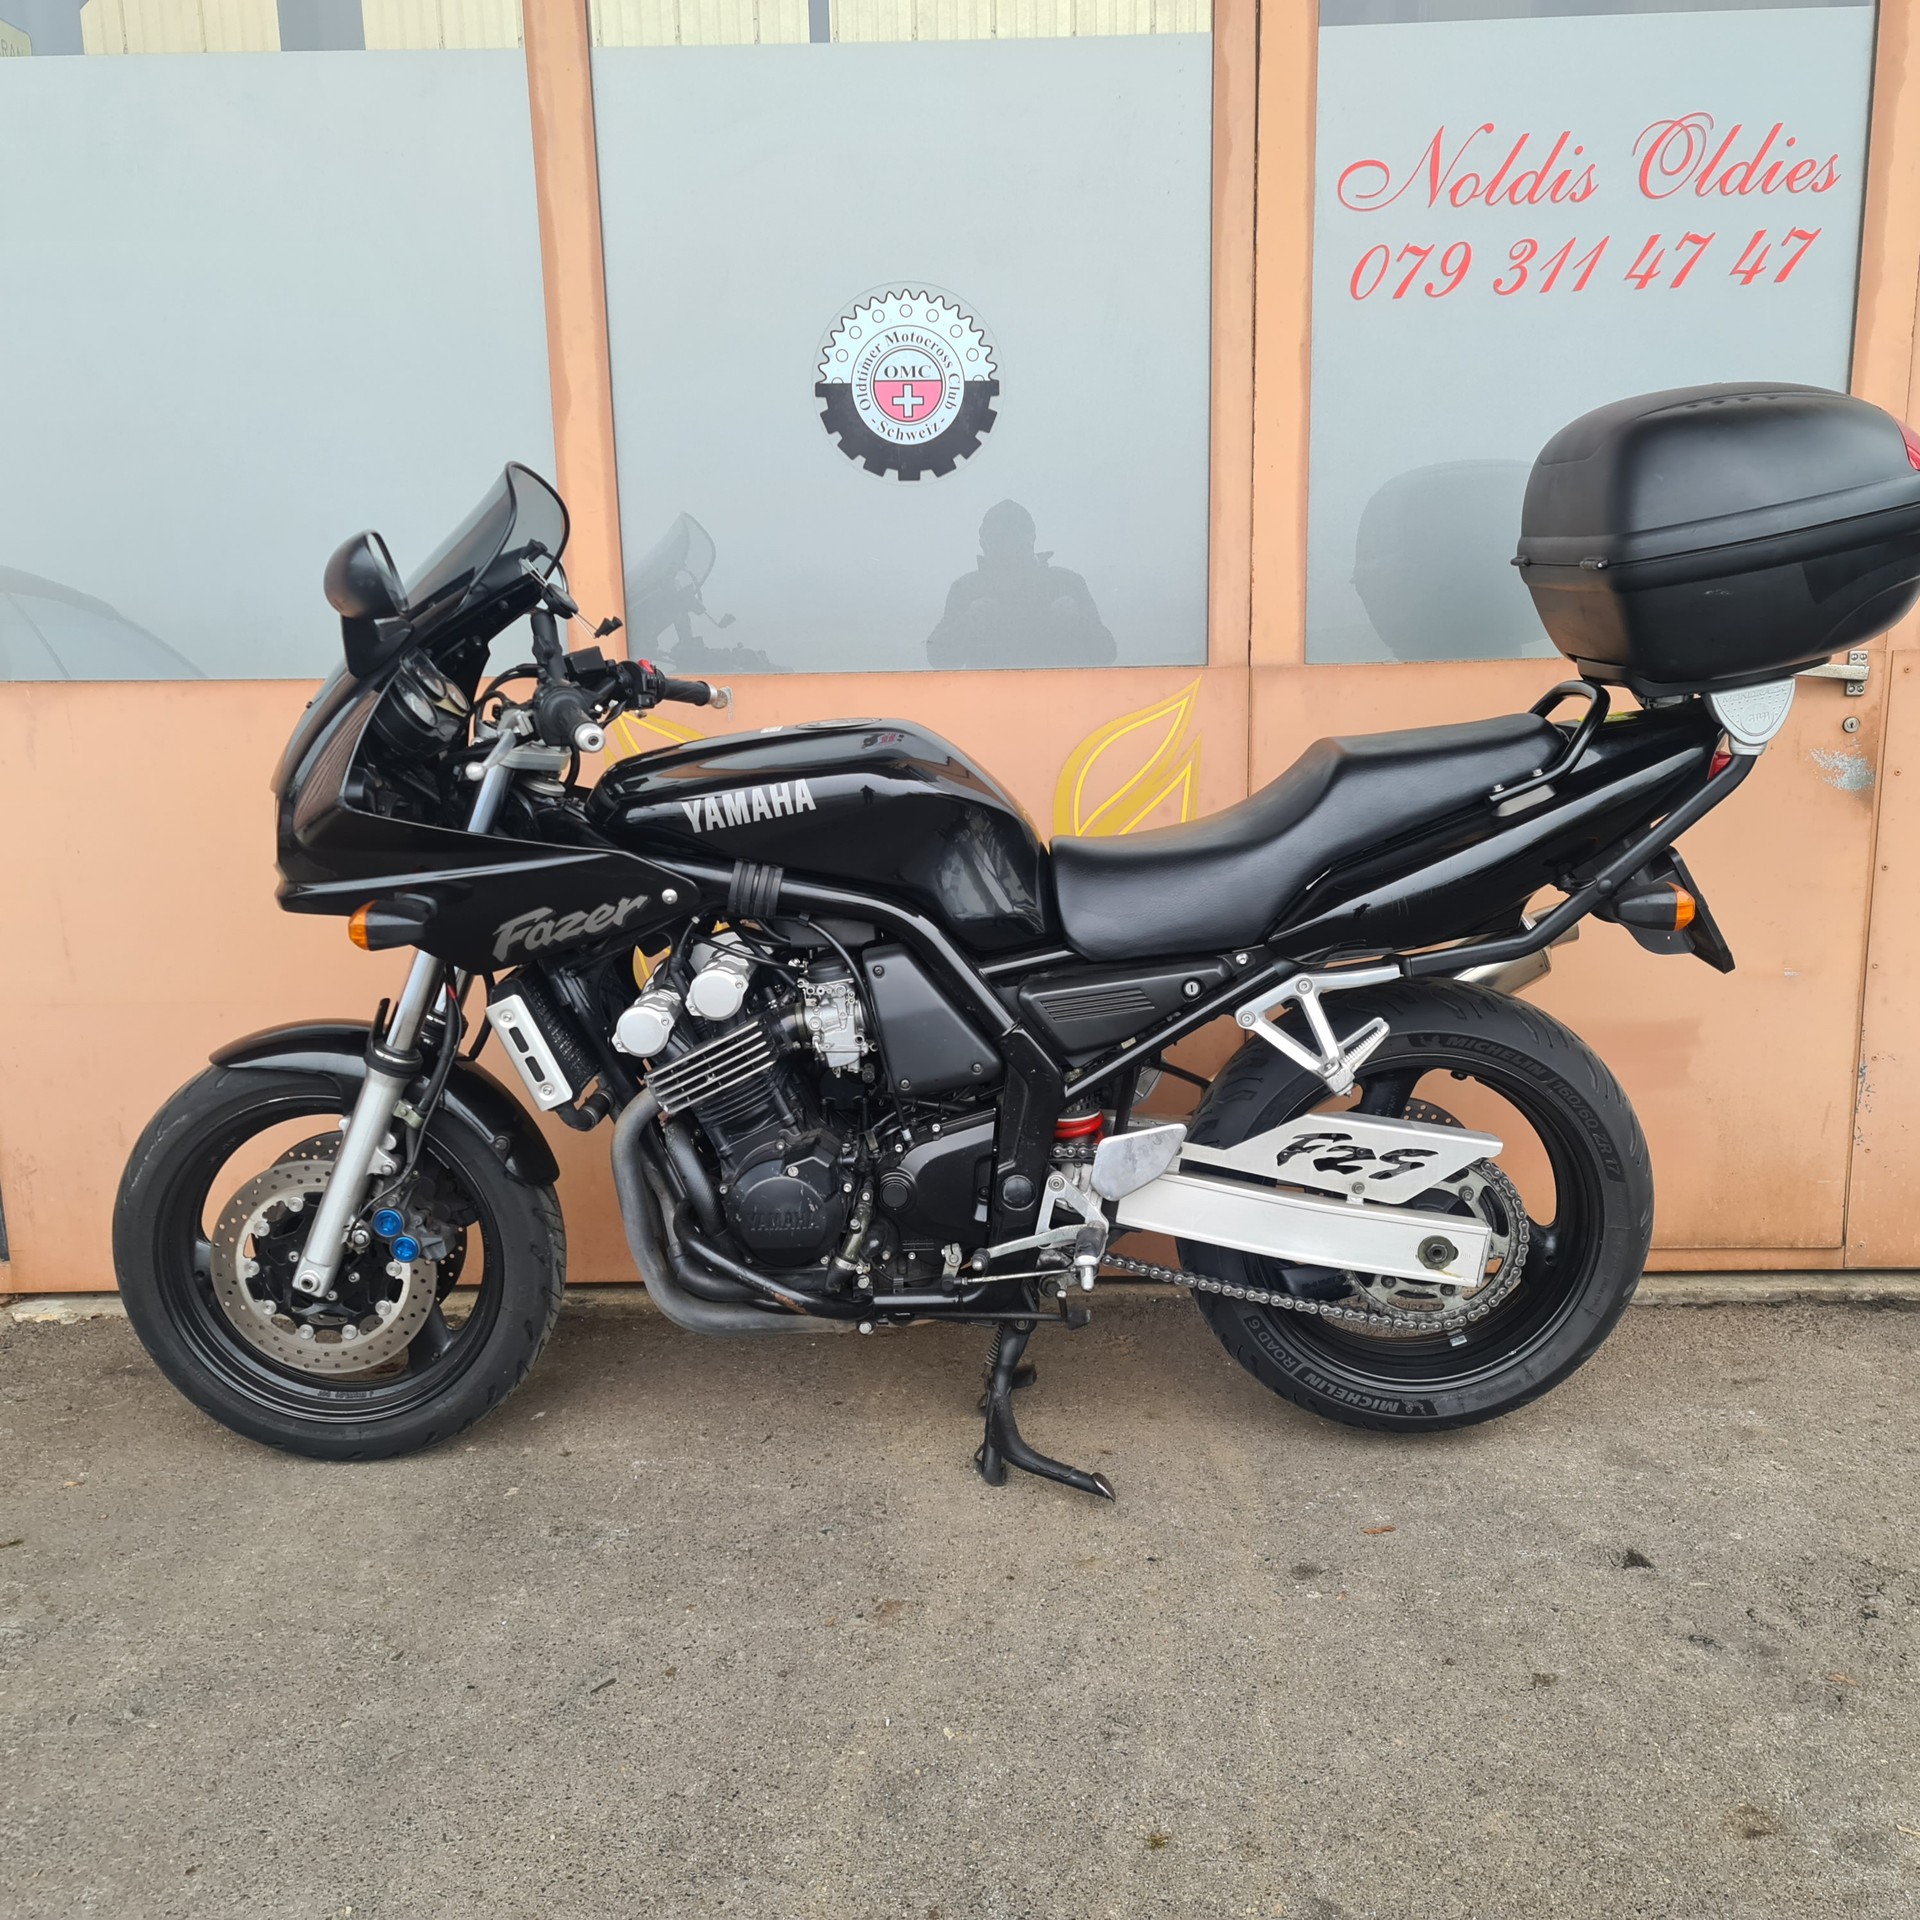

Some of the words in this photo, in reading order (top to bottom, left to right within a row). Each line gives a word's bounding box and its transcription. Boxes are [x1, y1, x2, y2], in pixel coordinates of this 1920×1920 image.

[1337, 122, 1599, 212] Noldis
[1632, 111, 1841, 200] Oldies
[1350, 241, 1472, 300] 079
[1493, 235, 1610, 296] 311
[1624, 231, 1716, 290] 47
[1729, 226, 1822, 285] 47
[856, 343, 881, 411] Oldtimer
[884, 331, 953, 369] Motocross
[945, 373, 961, 410] Club
[884, 365, 931, 378] OMC
[682, 779, 816, 833] YAMAHA
[492, 894, 648, 962] Fazer
[1445, 1036, 1547, 1078] MICHELIN
[1555, 1081, 1599, 1130] 160/60
[1593, 1132, 1612, 1154] ZR
[1604, 1159, 1620, 1175] 17
[1248, 1319, 1260, 1330] 6
[1257, 1331, 1296, 1369] ROAD
[1304, 1372, 1400, 1413] MICHELIN
